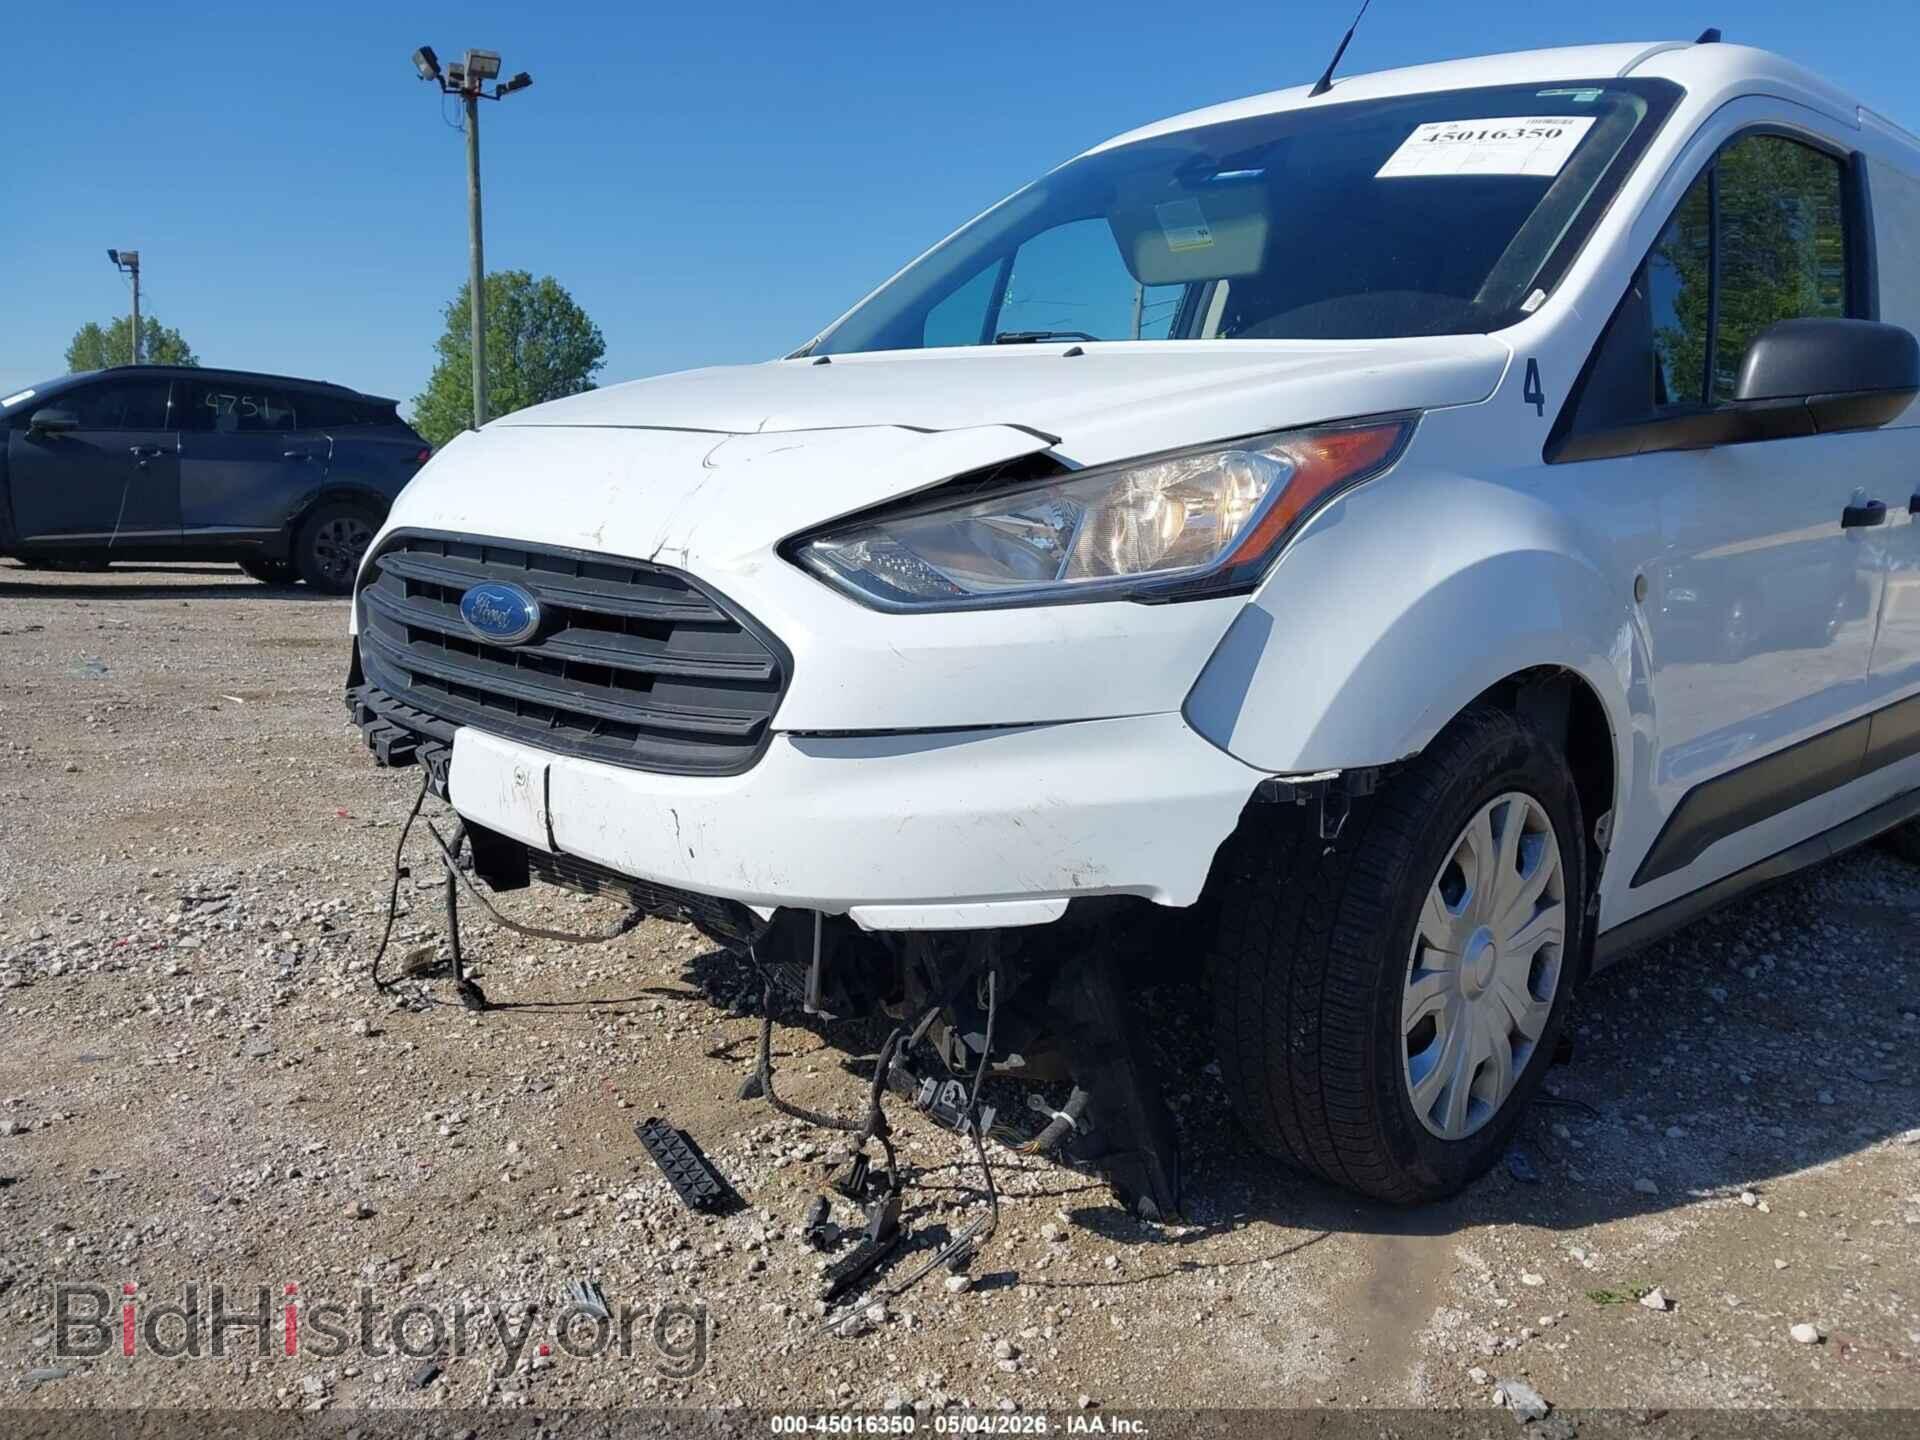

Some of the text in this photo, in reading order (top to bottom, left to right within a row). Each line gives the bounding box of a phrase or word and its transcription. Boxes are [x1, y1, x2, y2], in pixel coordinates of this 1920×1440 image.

[1422, 128, 1563, 143] 45016350
[1523, 357, 1545, 417] 4
[205, 393, 270, 419] 4751
[471, 591, 513, 629] Ford
